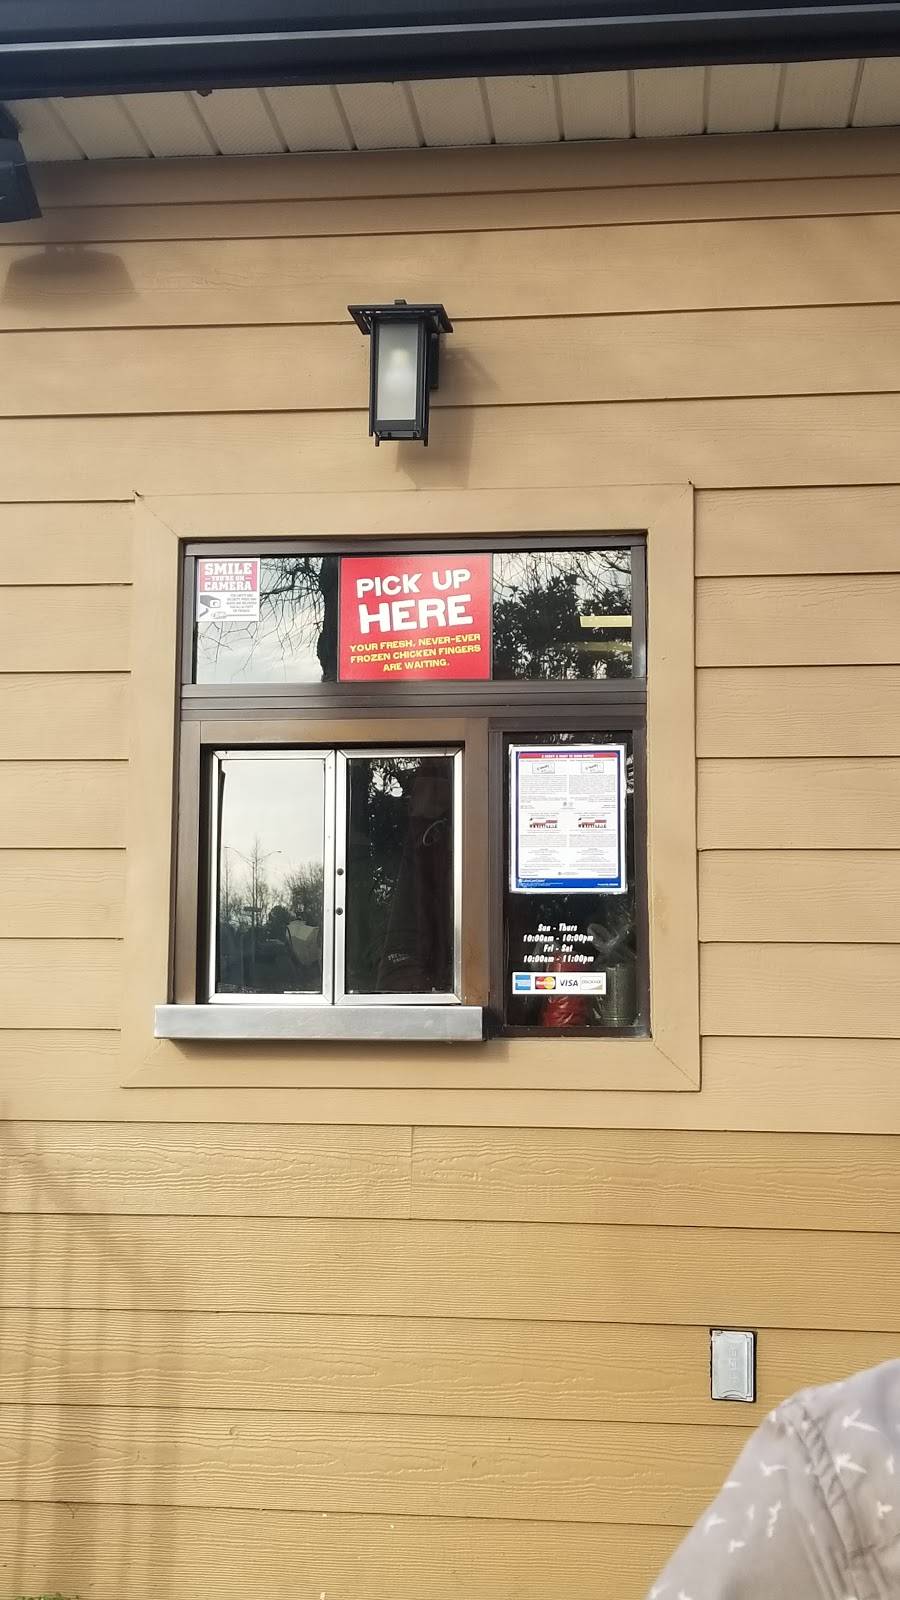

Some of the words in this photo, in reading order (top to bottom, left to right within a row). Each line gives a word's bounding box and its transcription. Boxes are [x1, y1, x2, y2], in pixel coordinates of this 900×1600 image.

[204, 562, 252, 576] SMILE
[204, 581, 252, 591] CAMERA
[356, 573, 422, 599] PICK
[432, 568, 471, 591] UP
[358, 594, 474, 634] HERE
[350, 643, 378, 653] YOUR
[380, 639, 416, 649] FRESH,
[418, 633, 481, 647] NEVER-EVER
[350, 652, 391, 664] FROZEN
[393, 647, 437, 660] CHICKEN
[438, 644, 481, 656] FINGERS
[383, 662, 402, 672] ARE
[404, 658, 450, 670] WAITING.
[538, 923, 551, 932] Sun
[558, 922, 578, 932] Thurs
[523, 934, 555, 943] 10:00am
[562, 933, 594, 944] 10:00pm
[543, 944, 554, 953] Fri
[561, 944, 573, 953] Sat
[523, 954, 555, 963] 10:00am
[562, 954, 595, 965] 11:00pm
[560, 979, 579, 987] VISA
